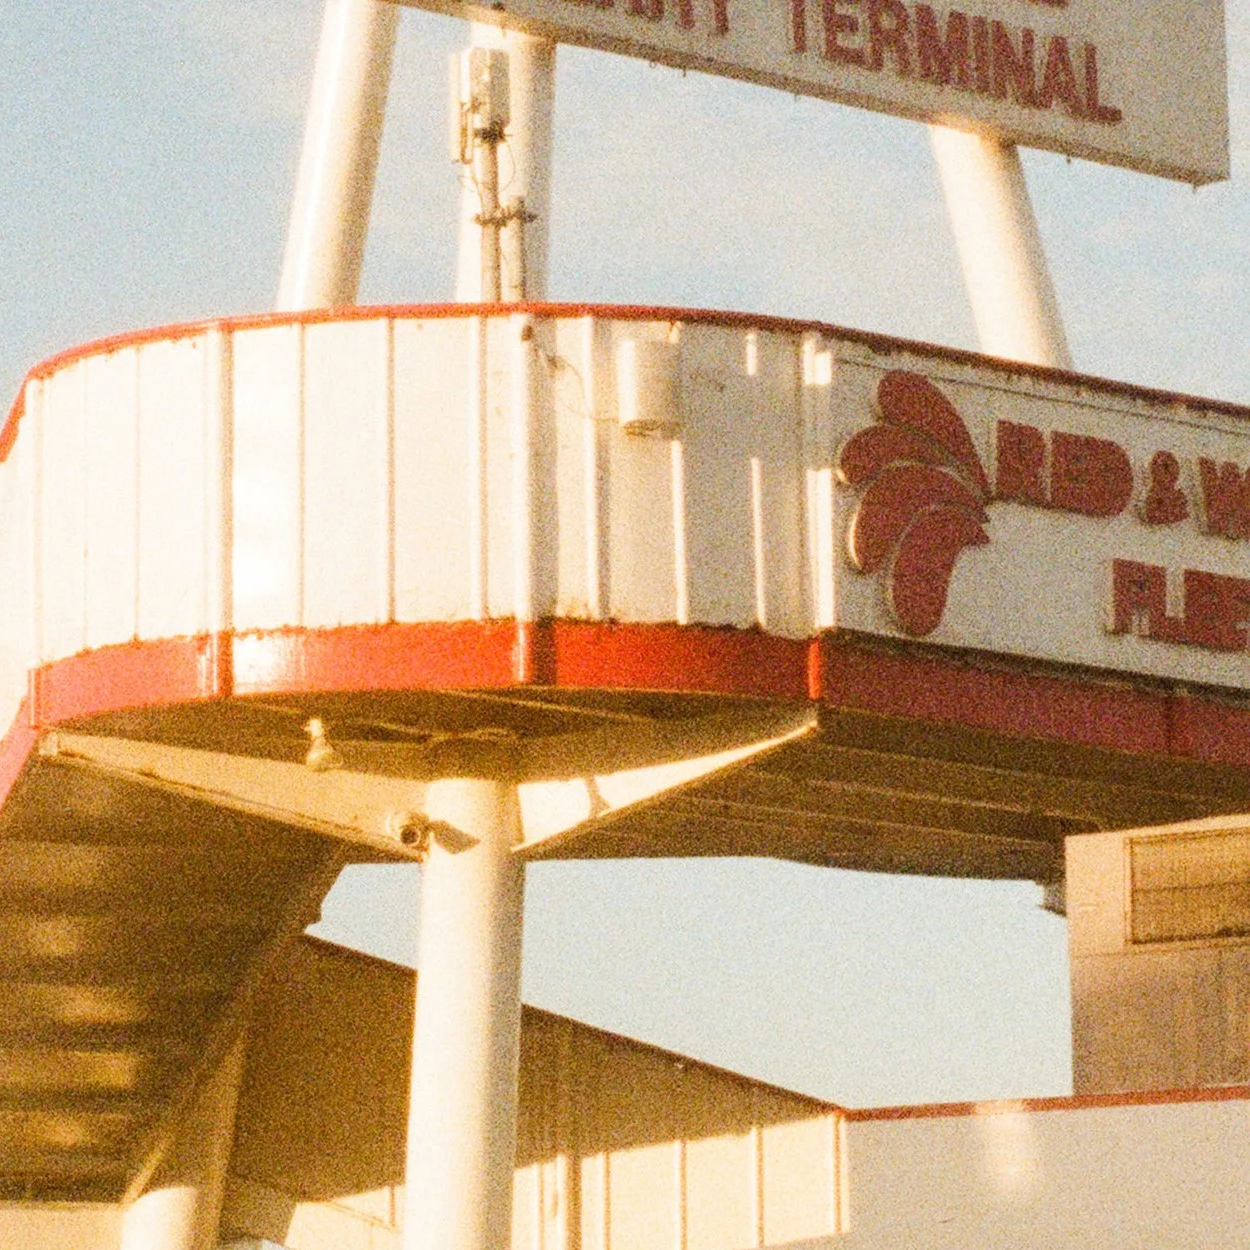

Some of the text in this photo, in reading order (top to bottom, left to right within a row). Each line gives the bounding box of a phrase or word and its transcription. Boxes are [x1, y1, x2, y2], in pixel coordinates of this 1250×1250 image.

[788, 0, 1123, 126] TERMINAL
[996, 419, 1134, 518] RED
[1145, 450, 1190, 526] &
